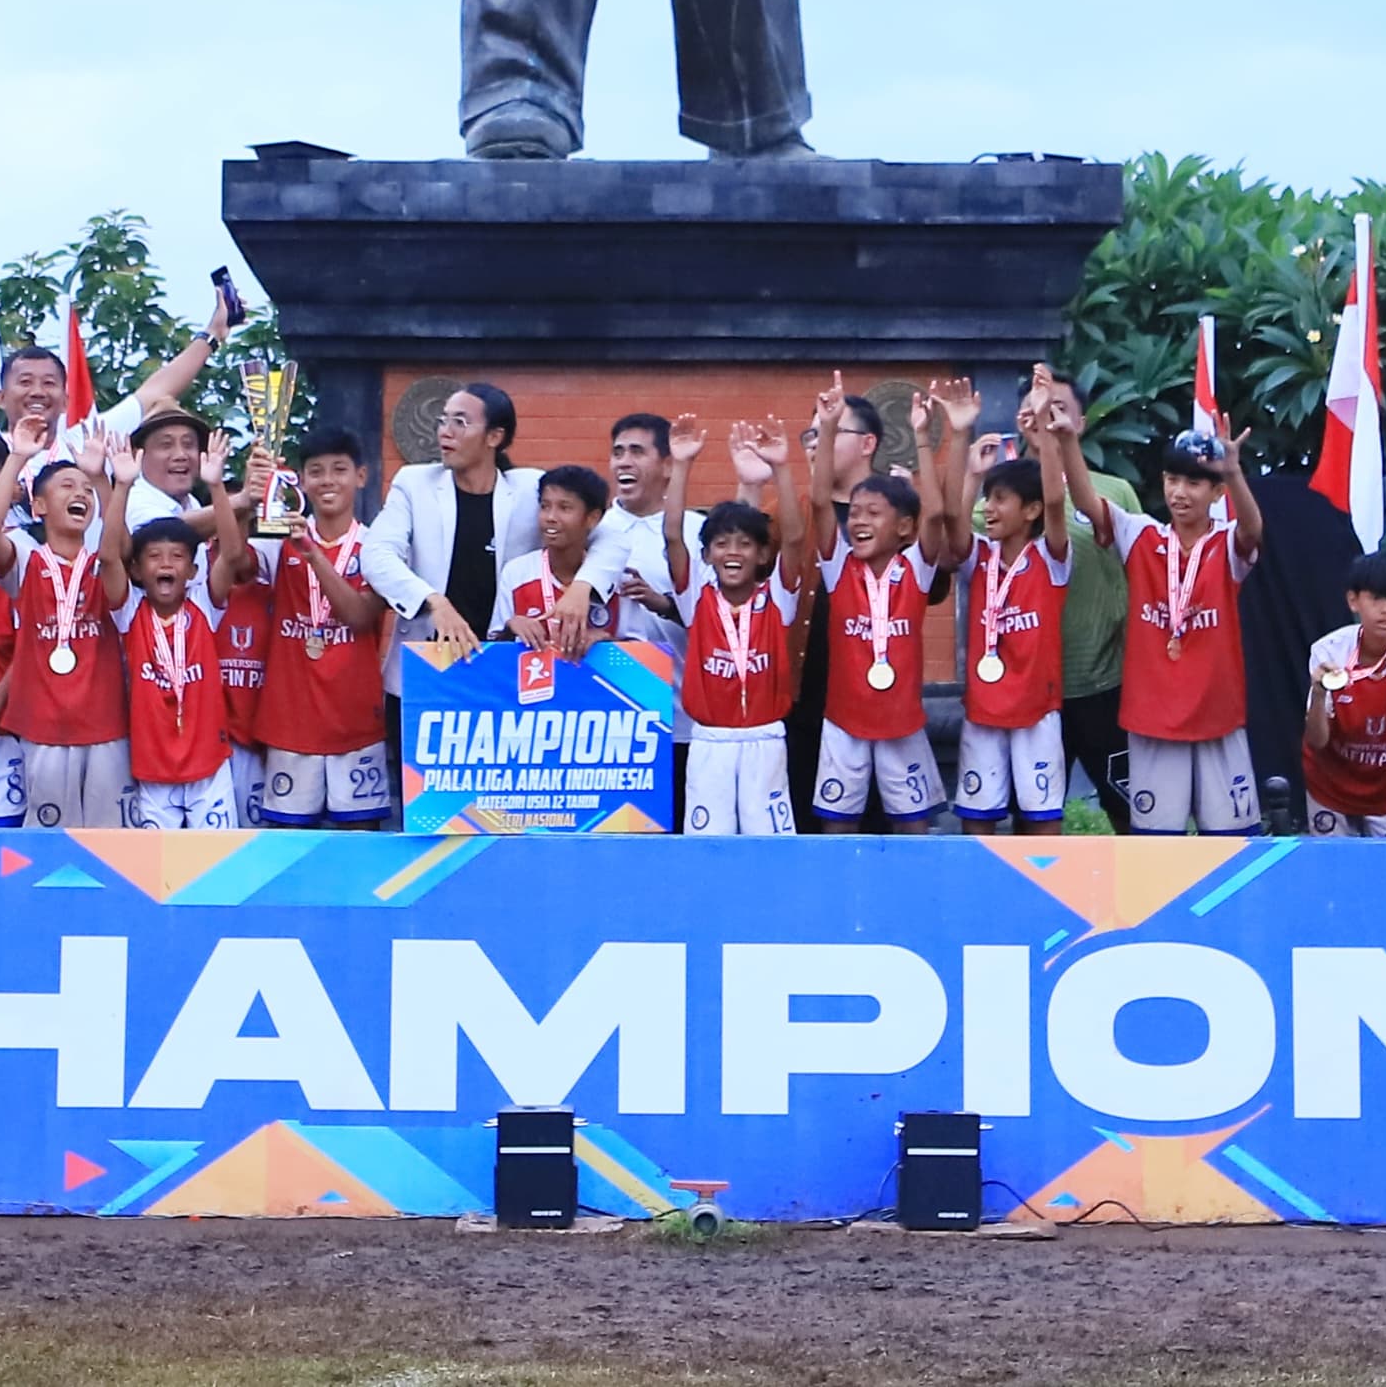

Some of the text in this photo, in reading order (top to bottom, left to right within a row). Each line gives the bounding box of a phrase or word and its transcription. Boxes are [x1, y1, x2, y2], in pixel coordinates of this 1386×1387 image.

[886, 619, 910, 636] ATI
[1005, 611, 1039, 633] PATI
[1193, 609, 1218, 629] ATI
[746, 653, 768, 673] ATI
[415, 710, 660, 765] CHAMPIONS
[7, 773, 25, 805] 8
[350, 767, 385, 799] 22
[423, 767, 654, 791] PIALA LIGA ANAK INDONESIA
[906, 773, 932, 804] 31
[1035, 773, 1050, 806] 9
[476, 795, 600, 810] KATEGORI USIA 12 TAHUN
[521, 813, 577, 828] NASIONAL
[766, 801, 792, 834] 12
